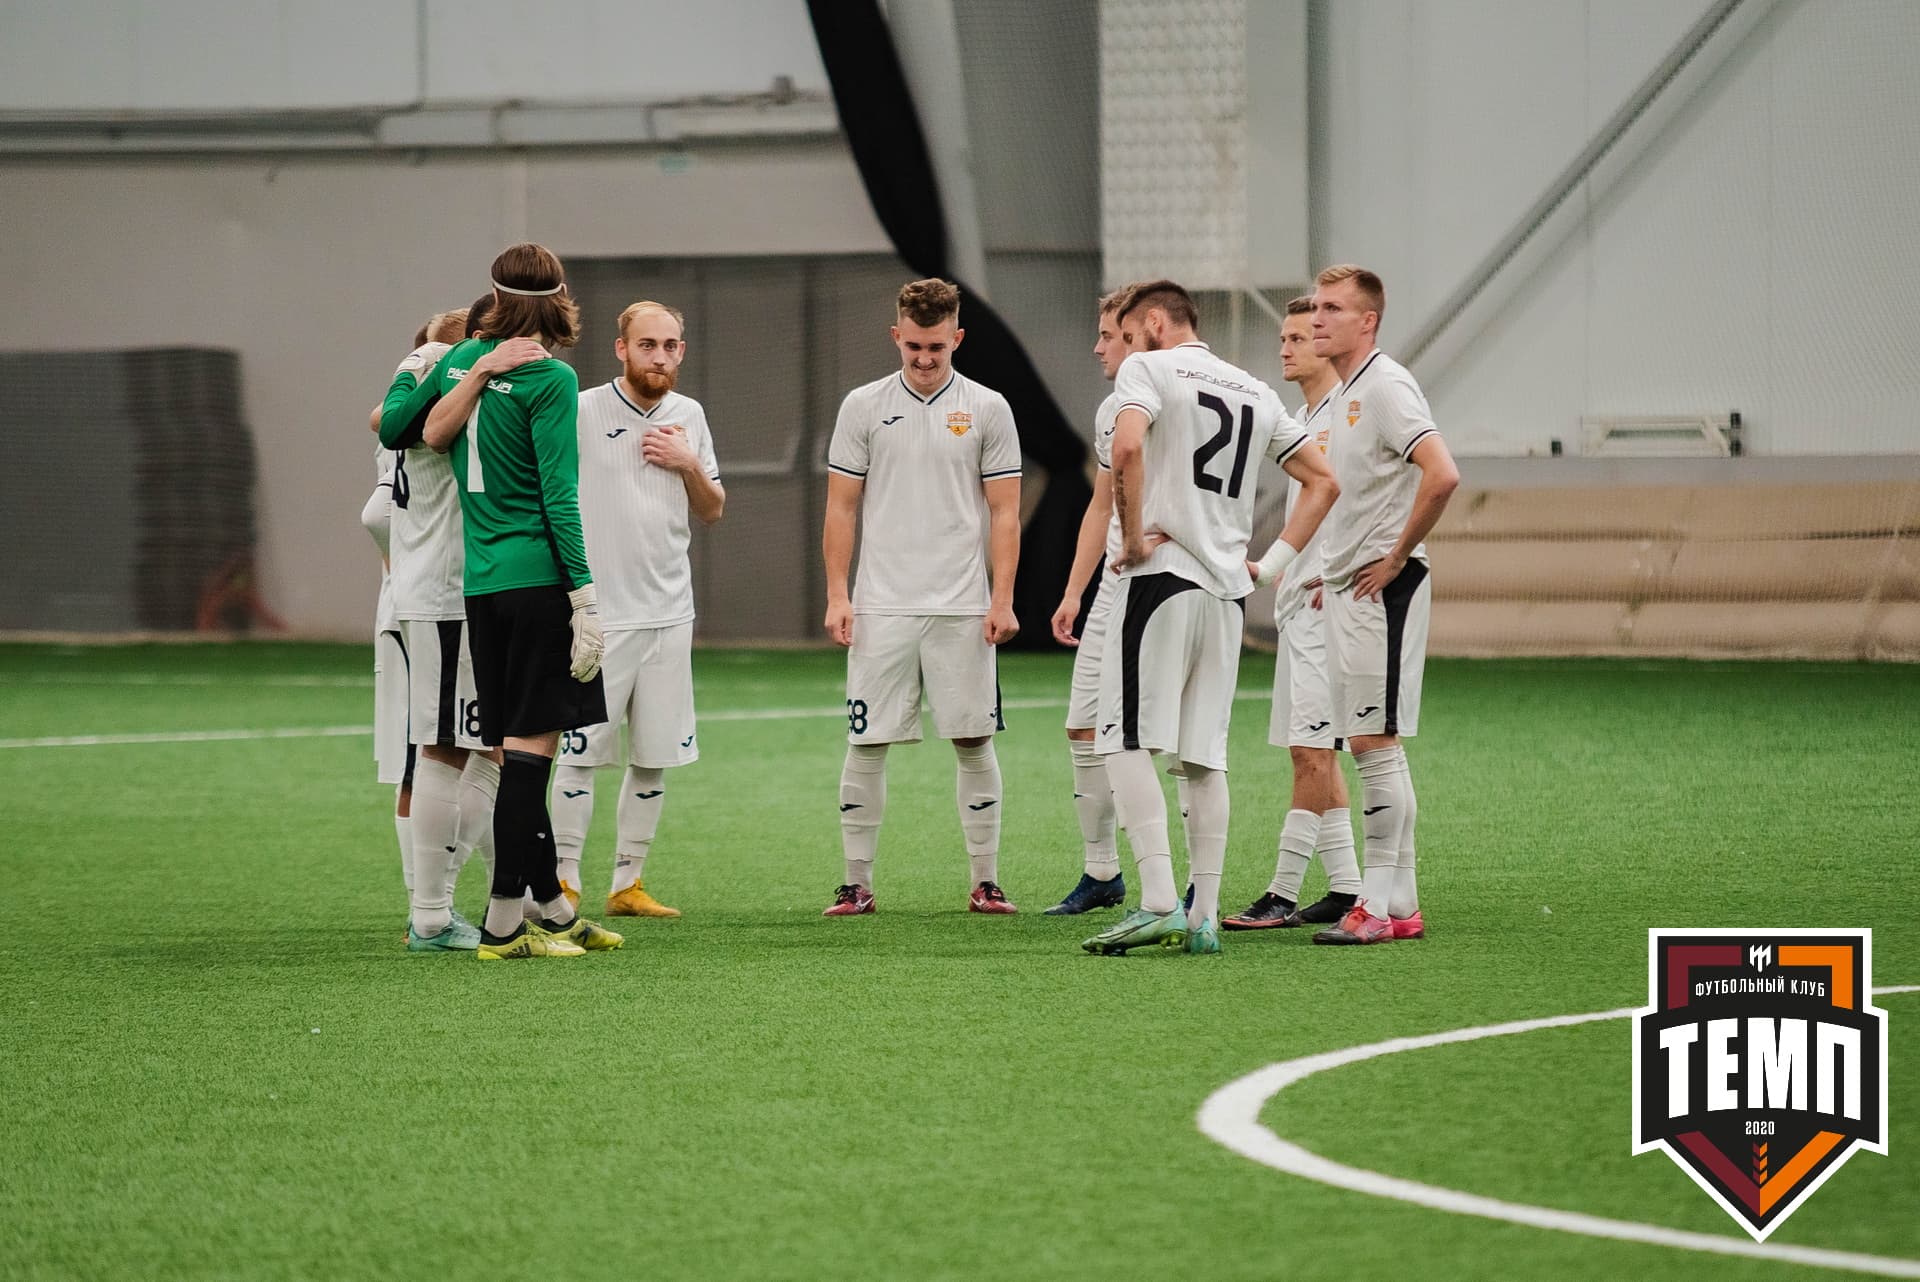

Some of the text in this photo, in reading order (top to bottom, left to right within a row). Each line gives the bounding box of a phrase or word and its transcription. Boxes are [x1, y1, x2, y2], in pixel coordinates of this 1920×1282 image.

[467, 394, 485, 492] 1
[1193, 390, 1254, 499] 21
[460, 698, 481, 737] 18
